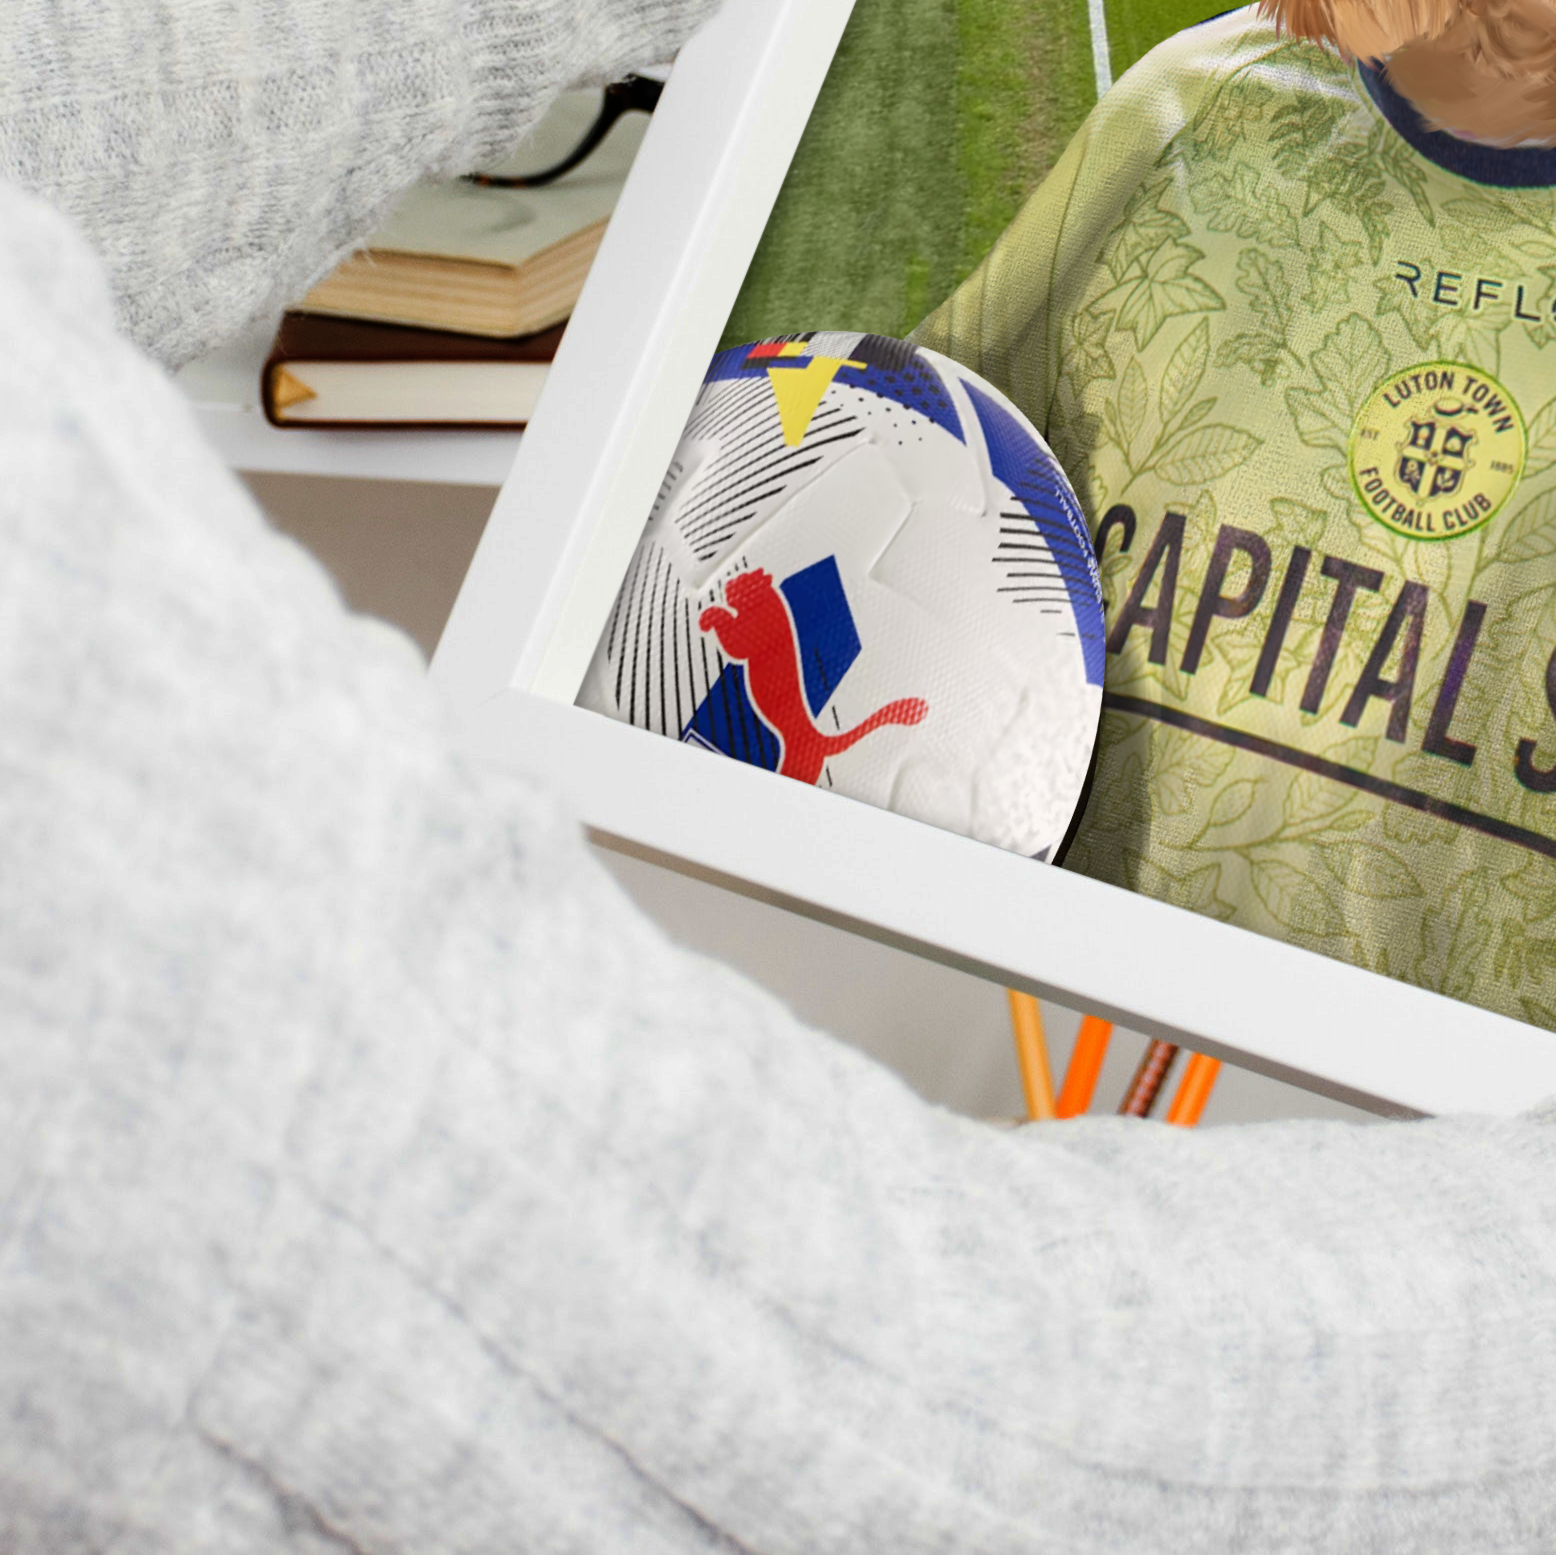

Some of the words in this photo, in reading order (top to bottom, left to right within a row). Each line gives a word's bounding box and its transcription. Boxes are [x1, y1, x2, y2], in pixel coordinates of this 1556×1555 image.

[1382, 370, 1456, 410] LUTON
[1462, 375, 1515, 435] TOWN
[1358, 466, 1436, 532] FOOTBALL
[1442, 491, 1493, 531] CLUB
